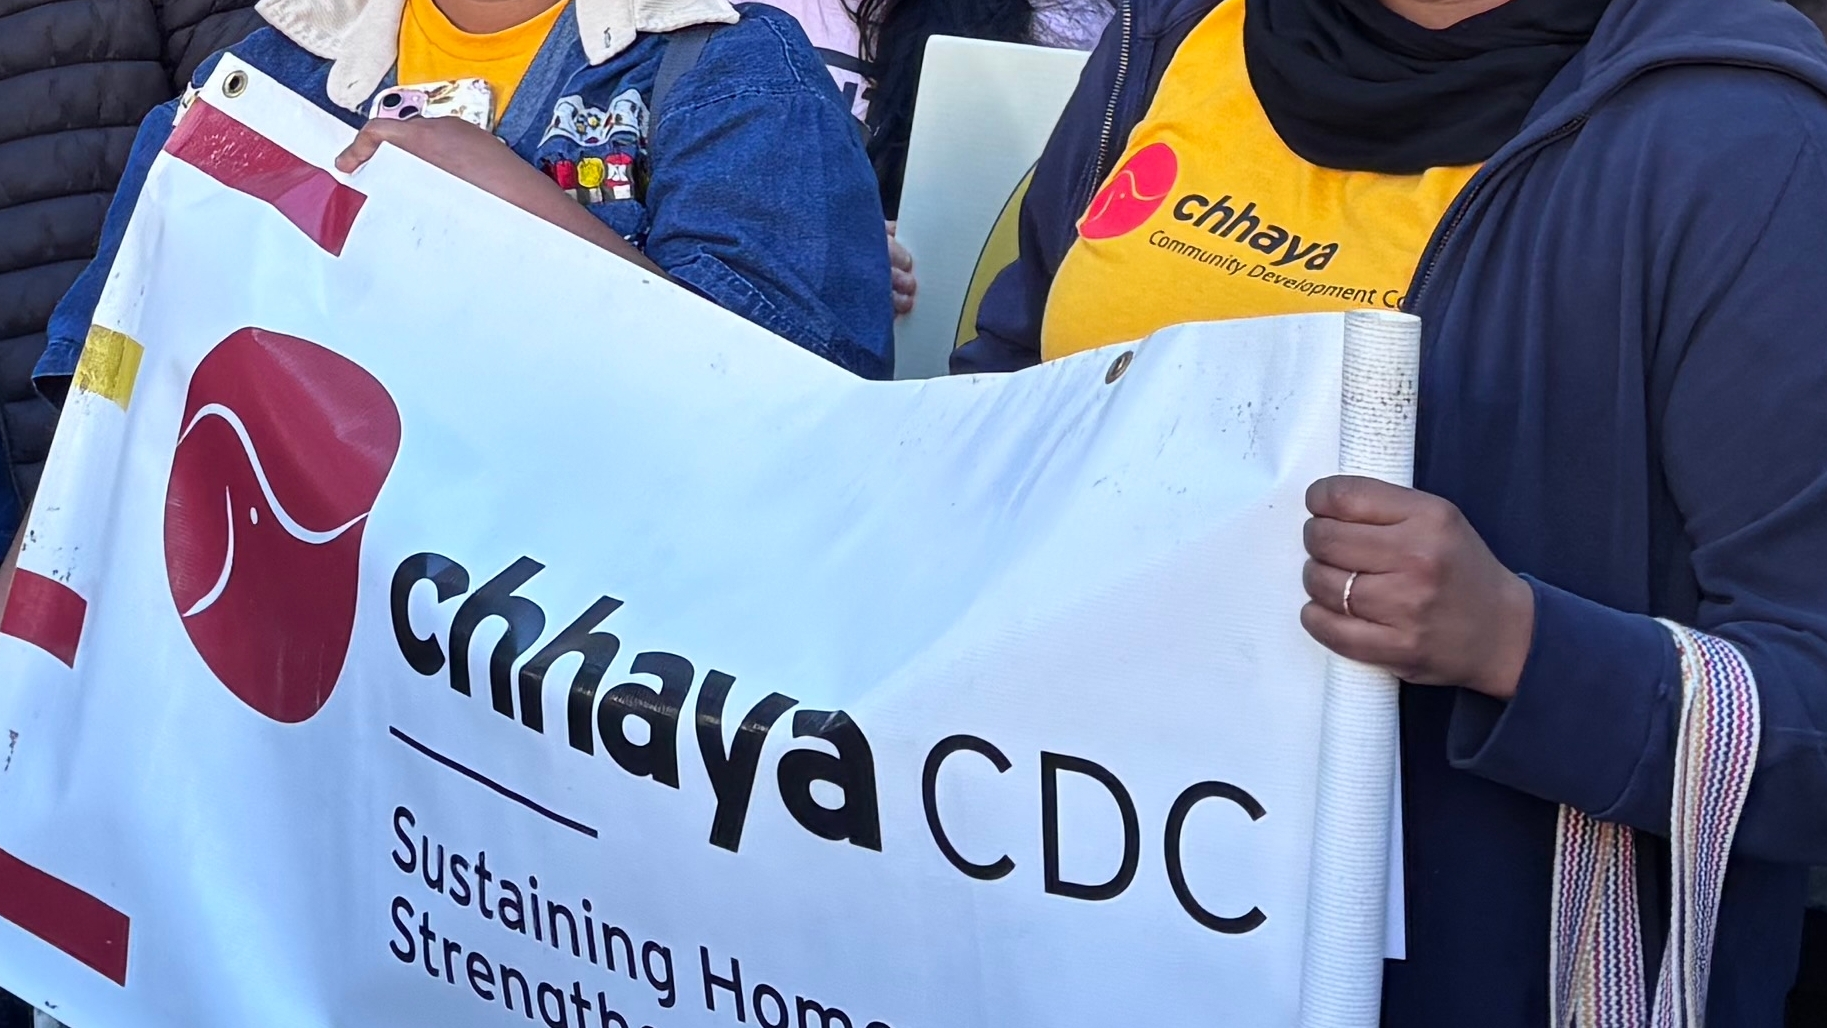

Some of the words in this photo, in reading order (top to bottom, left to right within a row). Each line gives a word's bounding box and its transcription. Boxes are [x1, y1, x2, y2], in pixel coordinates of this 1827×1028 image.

[1148, 229, 1248, 276] Community
[1247, 264, 1378, 305] Development
[1172, 193, 1339, 272] chhaya
[389, 552, 882, 852] chhaya
[922, 735, 1268, 935] CDC
[391, 805, 676, 1009] Sustaining
